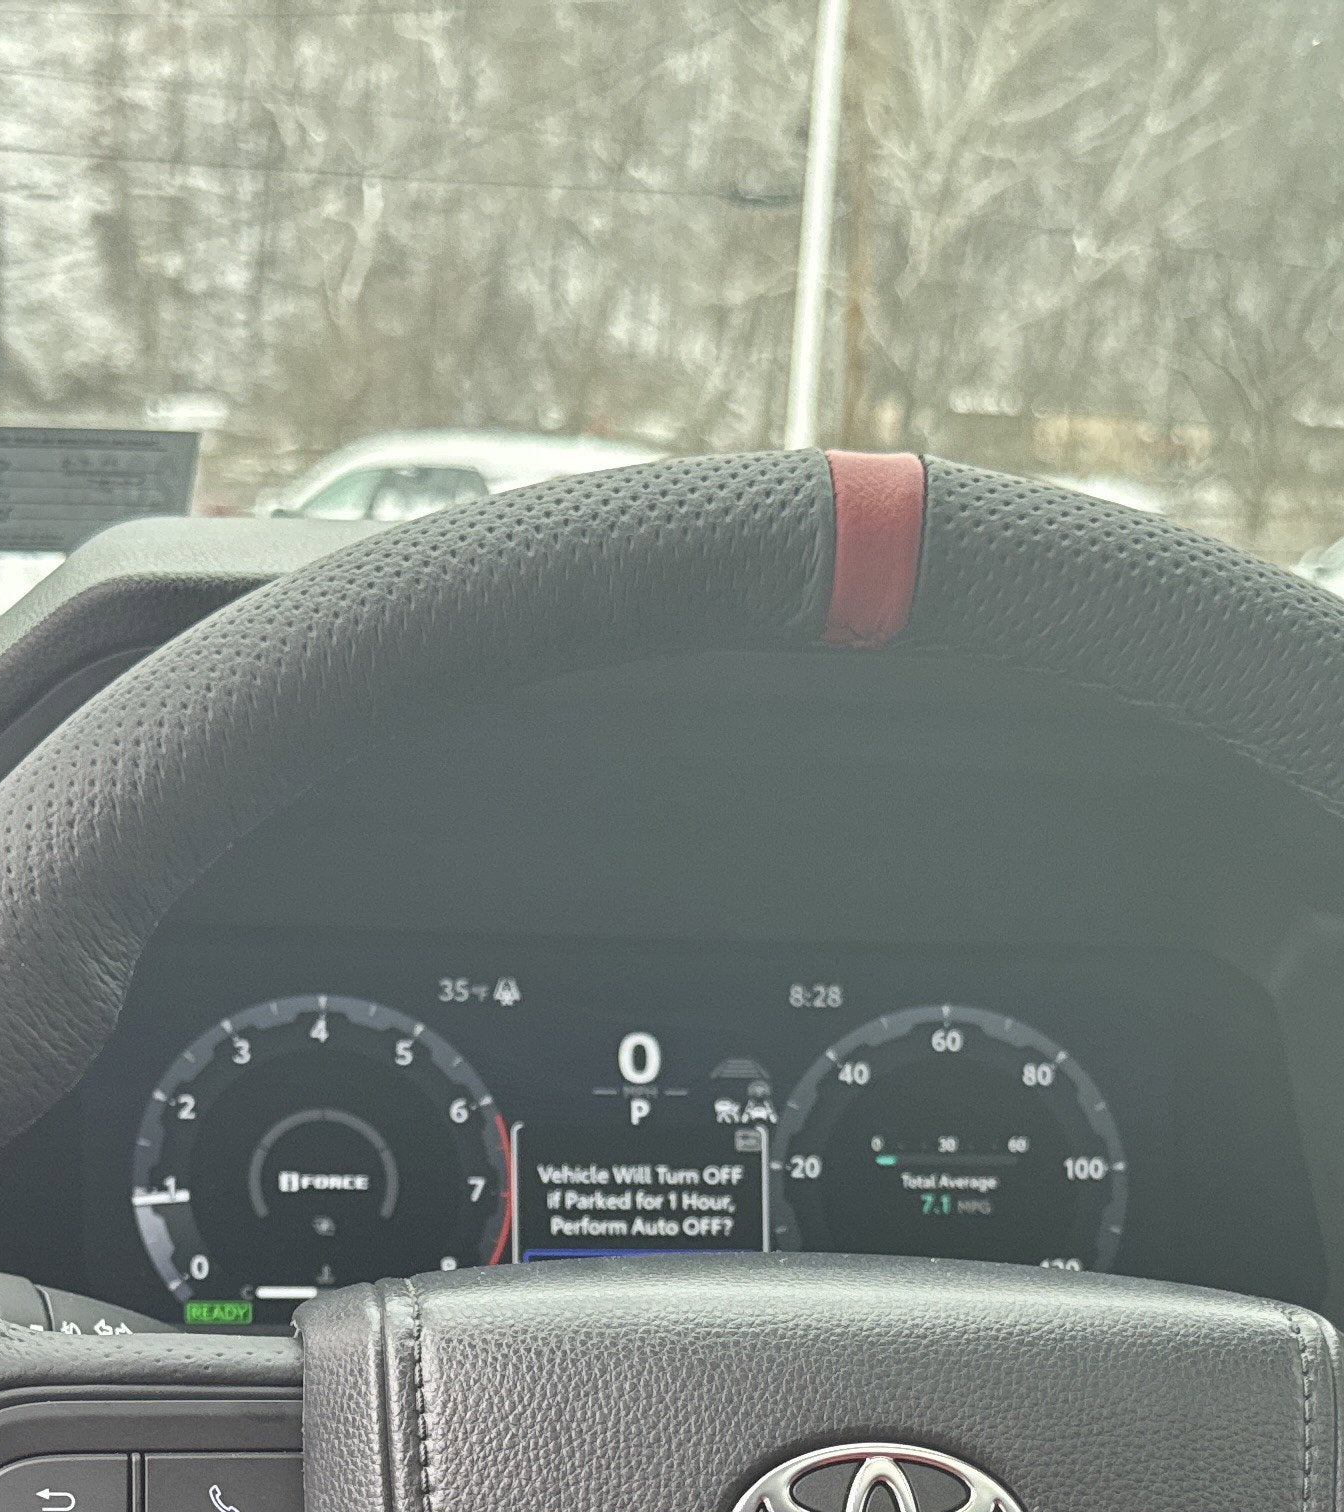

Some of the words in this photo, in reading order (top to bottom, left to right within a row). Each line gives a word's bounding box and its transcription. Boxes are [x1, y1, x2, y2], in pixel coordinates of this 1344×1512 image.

[789, 984, 844, 1008] 8:28
[309, 1019, 328, 1043] 4
[931, 1030, 963, 1054] 60
[232, 1040, 252, 1065] 3
[394, 1040, 414, 1066] 5
[617, 1031, 662, 1085] 0
[838, 1062, 870, 1086] 40
[1023, 1062, 1055, 1087] 80
[176, 1094, 196, 1120] 2
[449, 1099, 470, 1125] 6
[630, 1099, 651, 1126] P
[537, 1163, 609, 1185] Vehicle
[612, 1163, 652, 1185] Will
[655, 1165, 699, 1185] Turn
[702, 1165, 745, 1186] OFF
[790, 1155, 822, 1180] 20
[1064, 1157, 1106, 1181] 100
[466, 1177, 488, 1202] 7
[900, 1172, 936, 1190] Total
[938, 1172, 998, 1194] Average
[564, 1189, 632, 1211] Parked
[635, 1189, 664, 1211] for
[668, 1190, 677, 1211] 1
[920, 1191, 951, 1216] 7.1
[550, 1213, 628, 1236] Perform
[630, 1215, 680, 1237] Auto
[682, 1215, 735, 1237] OFF?
[189, 1254, 210, 1281] 0
[191, 1302, 249, 1321] READY
